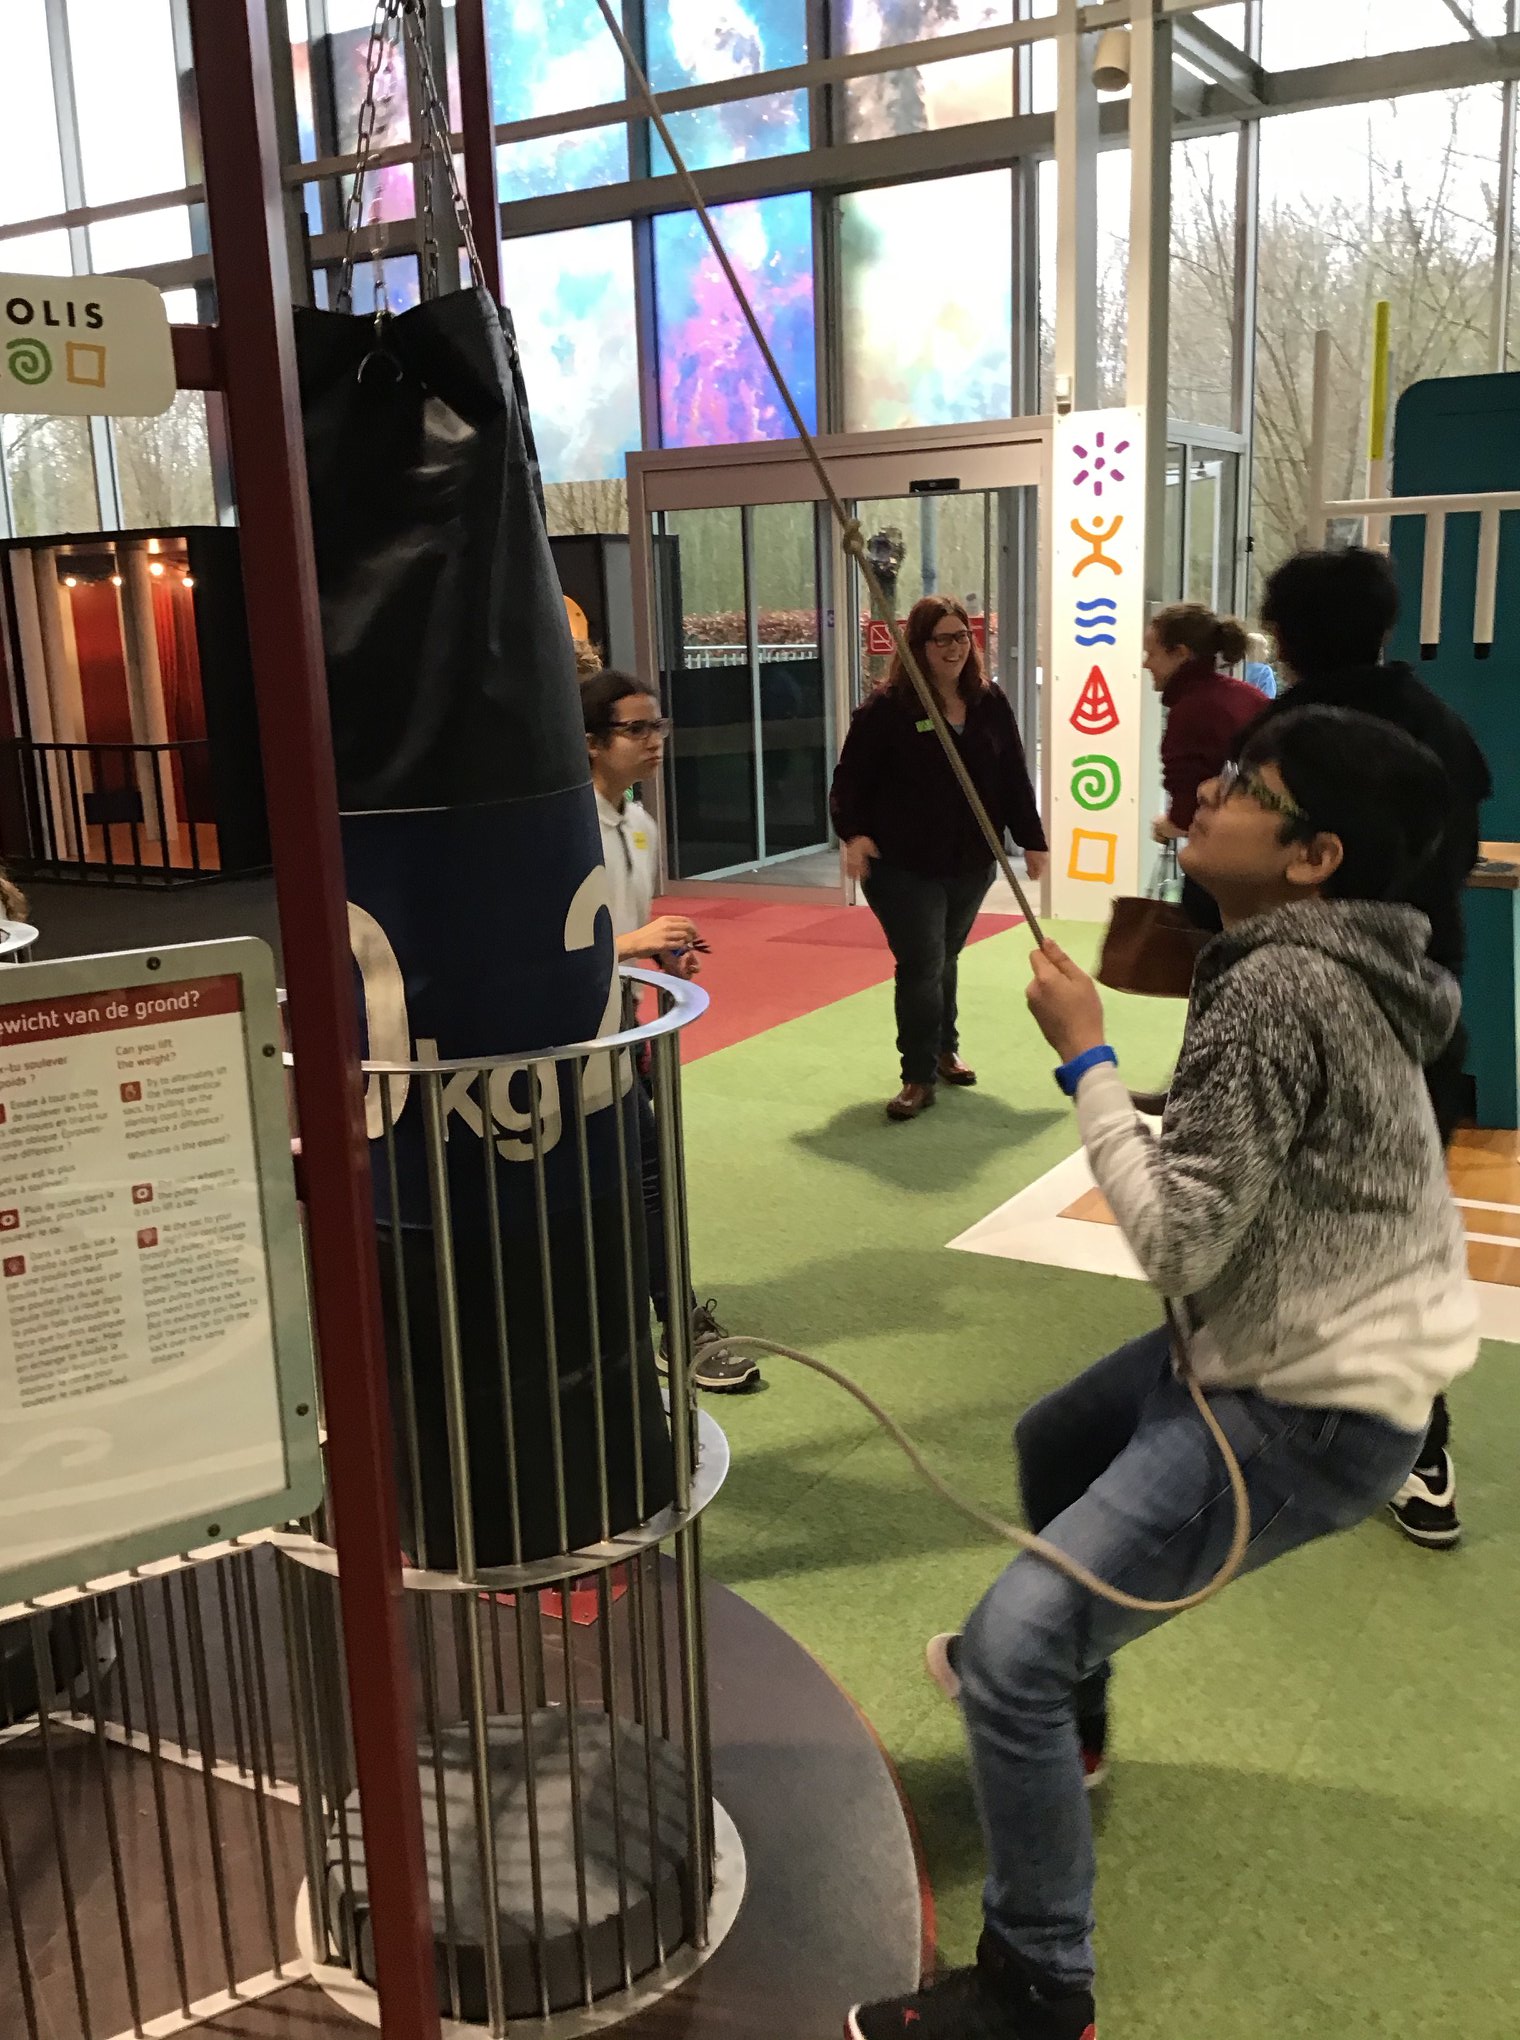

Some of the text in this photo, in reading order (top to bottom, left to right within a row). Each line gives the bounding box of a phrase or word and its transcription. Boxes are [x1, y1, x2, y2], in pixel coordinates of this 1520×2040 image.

[6, 297, 104, 329] OLIS
[64, 1008, 100, 1025] van
[105, 1001, 129, 1019] de
[135, 989, 200, 1020] grond?
[115, 1045, 135, 1056] Can
[137, 1043, 156, 1055] you
